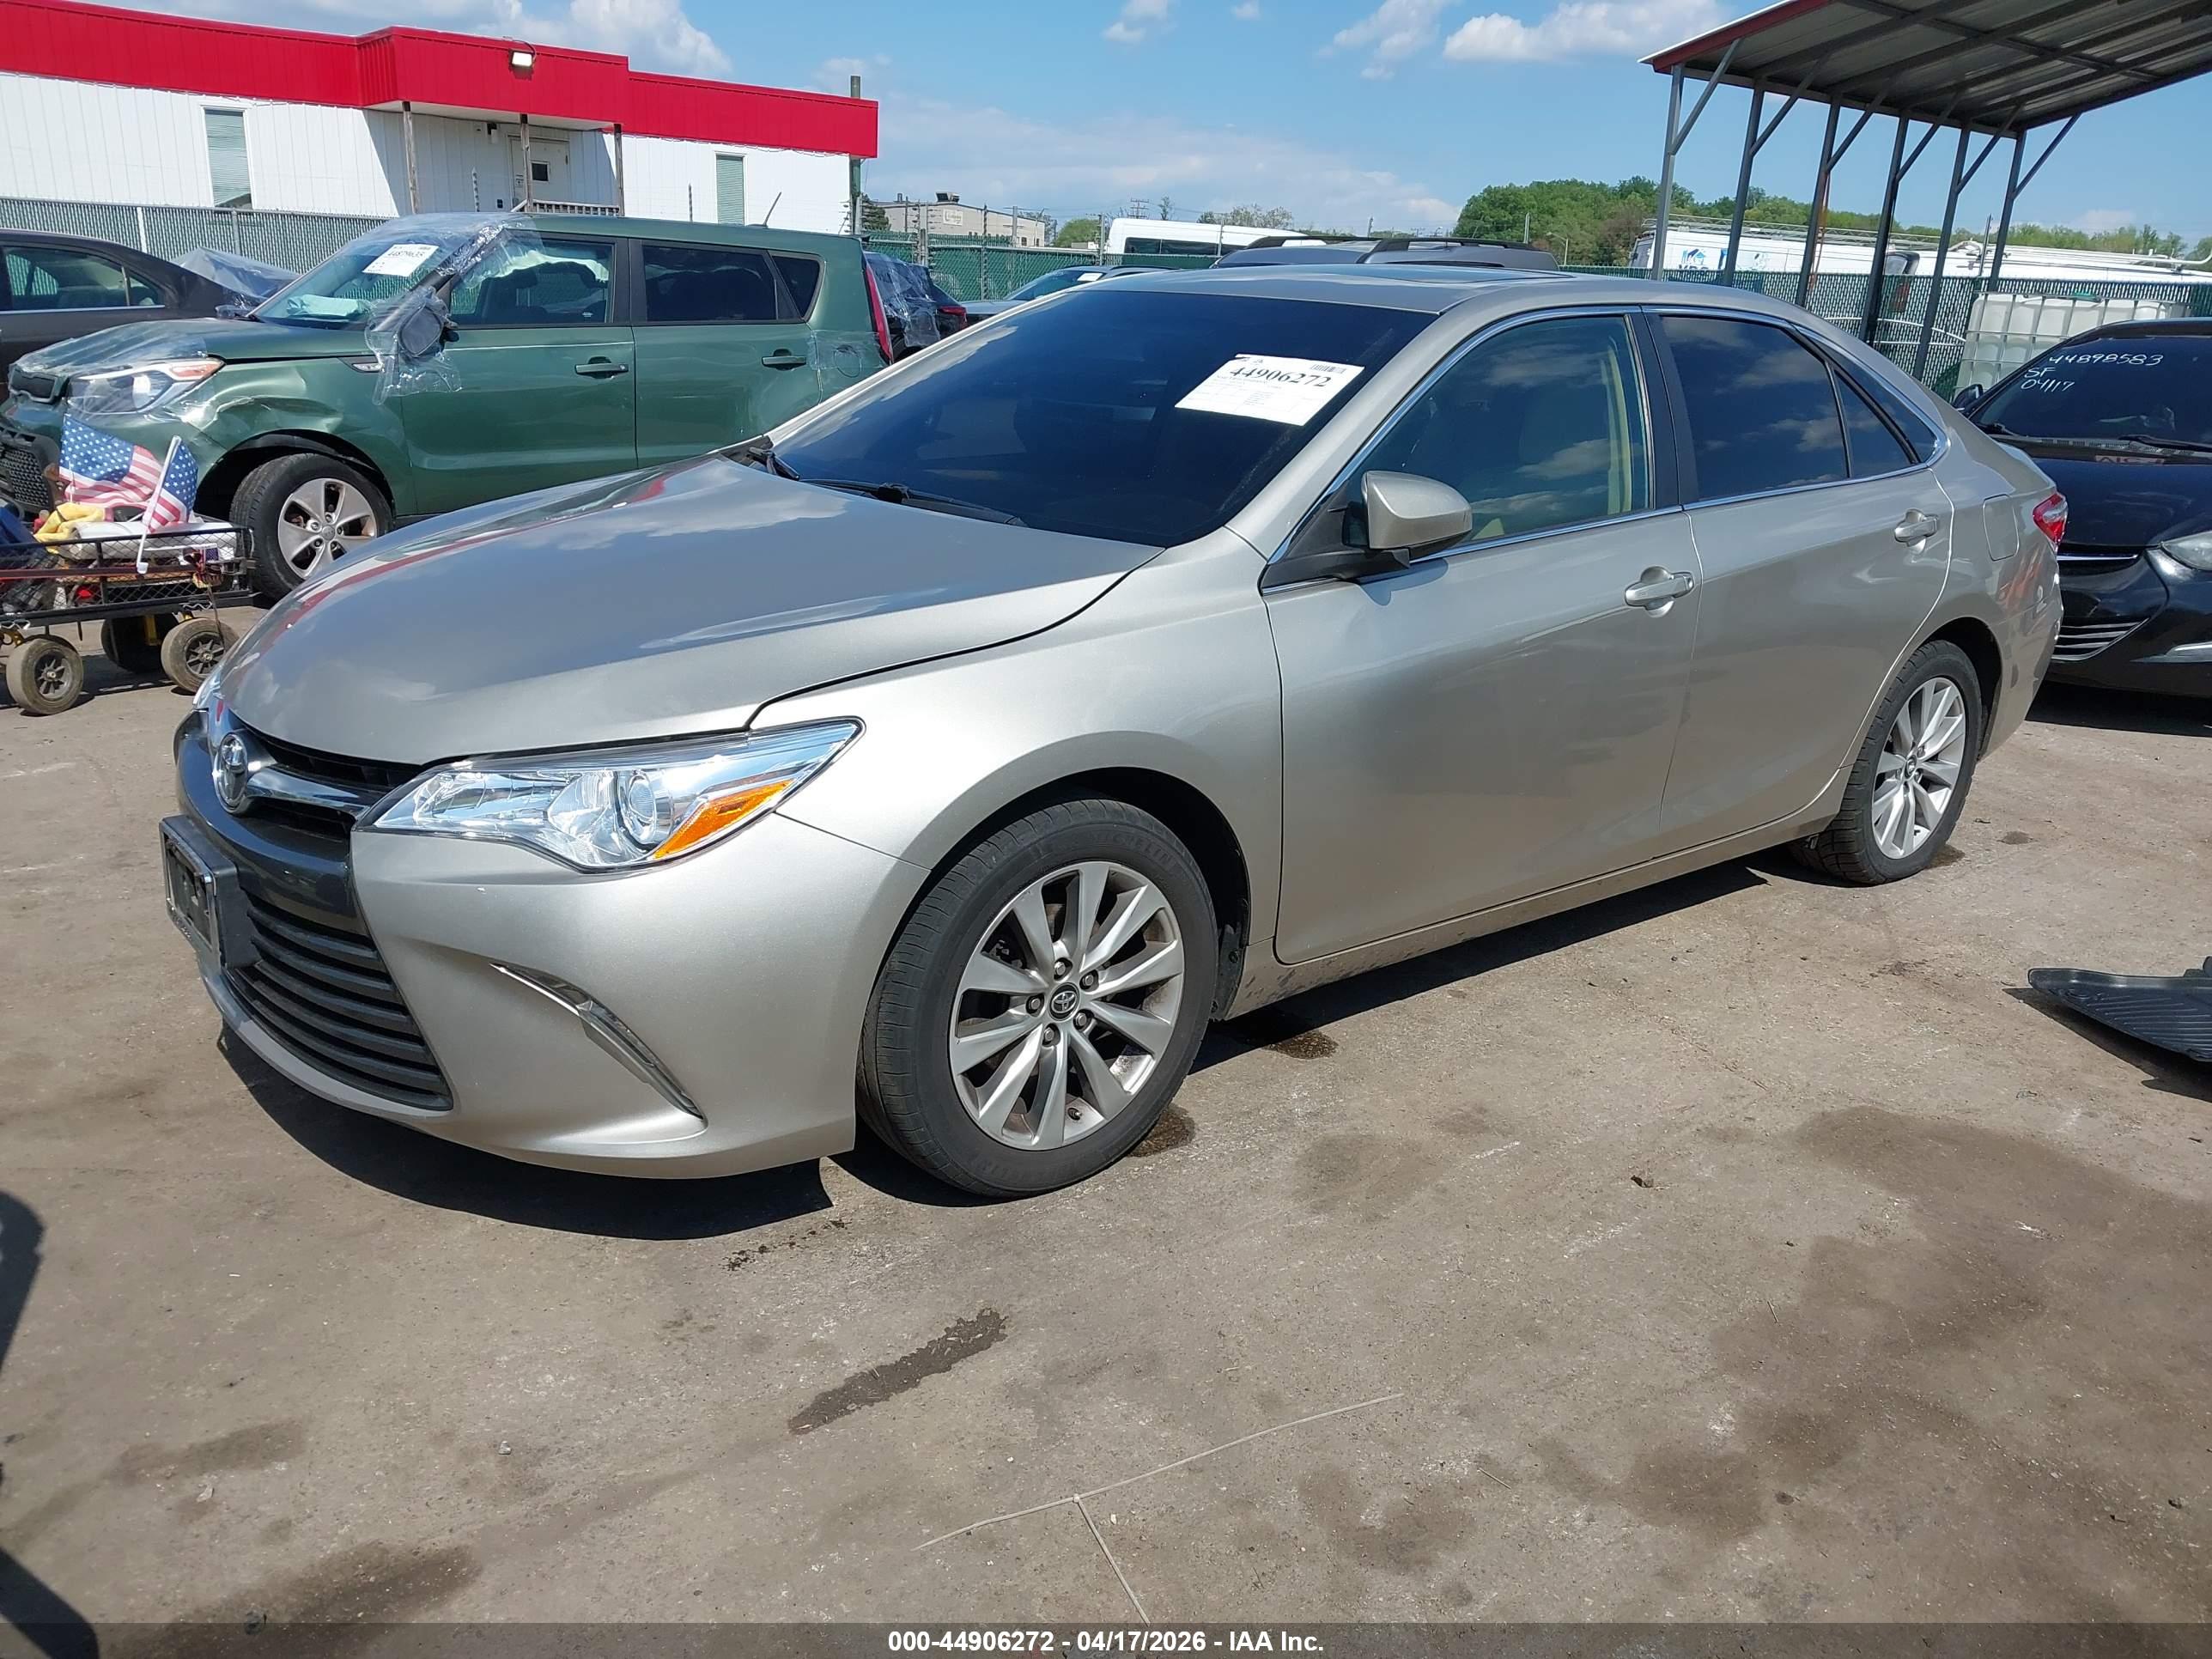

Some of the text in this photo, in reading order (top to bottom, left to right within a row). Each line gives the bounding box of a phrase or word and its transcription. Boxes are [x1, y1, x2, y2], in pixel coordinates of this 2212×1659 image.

[2049, 353, 2164, 366] 44898583
[1230, 367, 1332, 387] 44906272
[2024, 367, 2056, 379] SF
